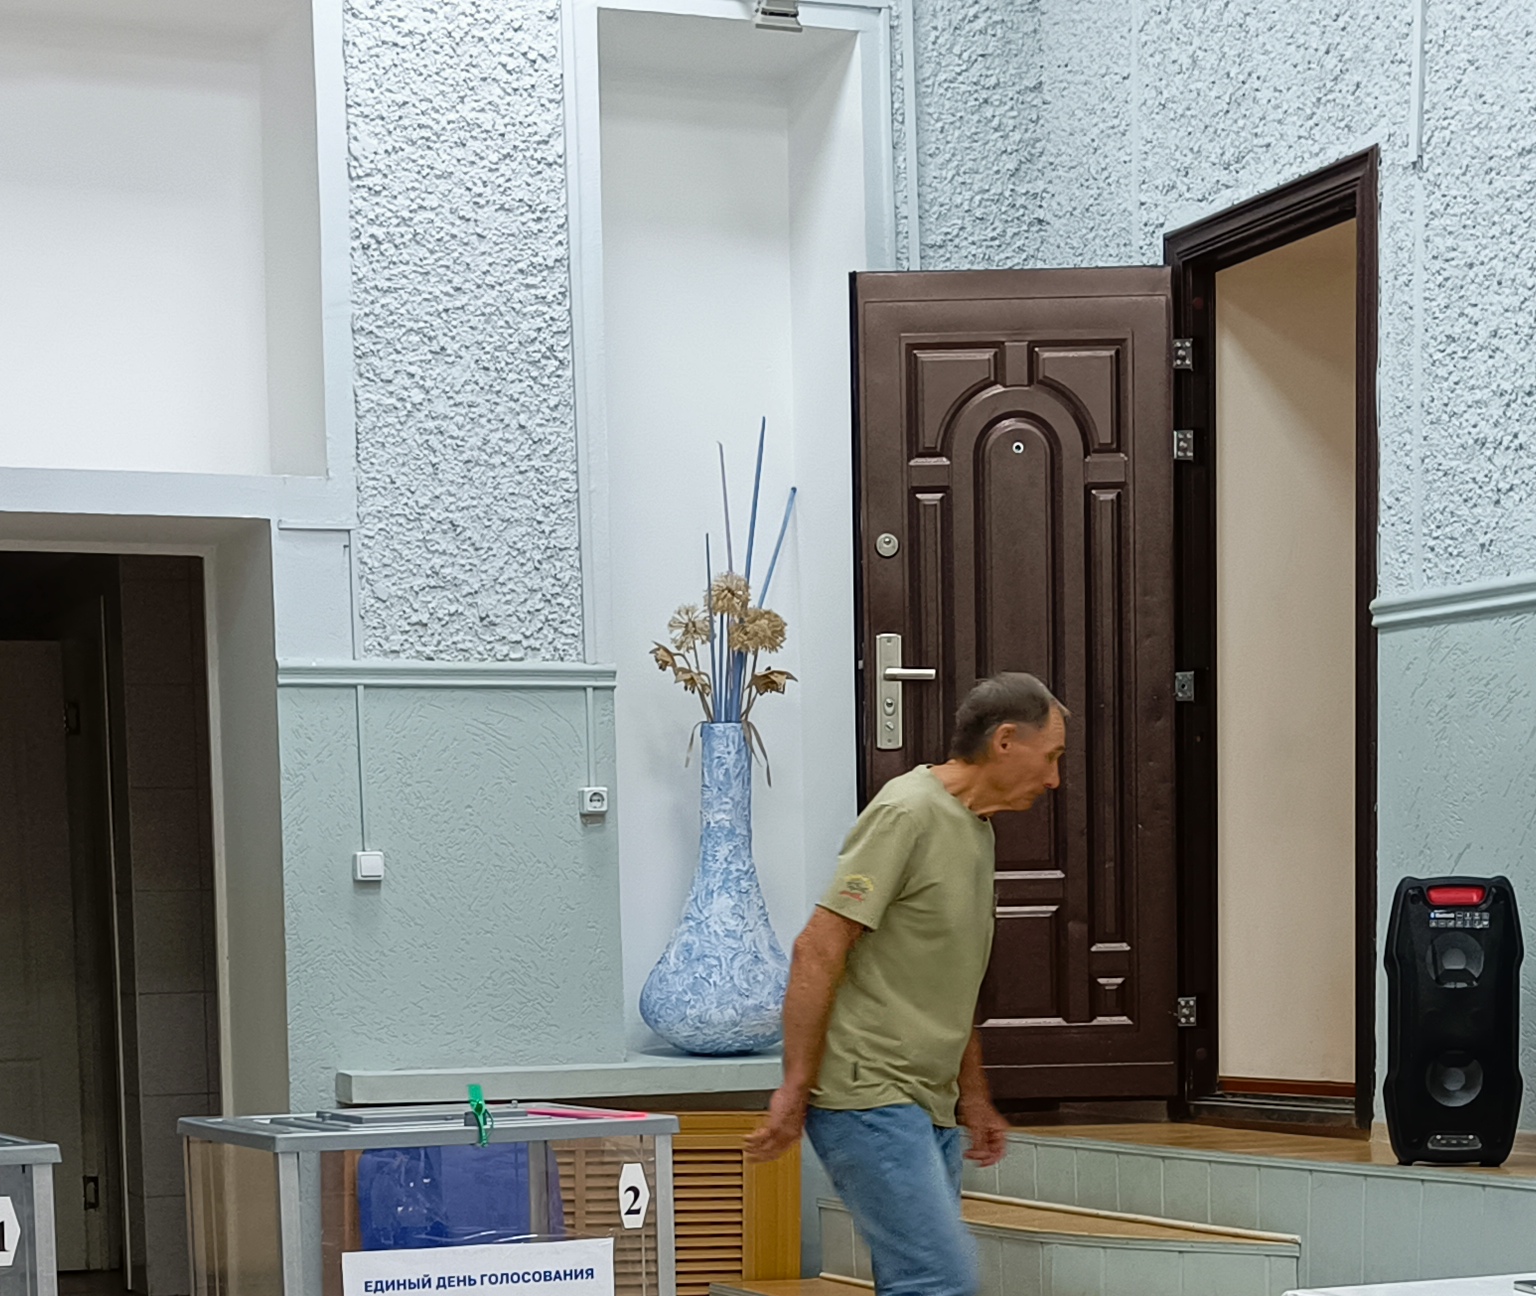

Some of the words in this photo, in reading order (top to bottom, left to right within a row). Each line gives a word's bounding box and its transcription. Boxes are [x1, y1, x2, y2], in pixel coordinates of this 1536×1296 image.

[624, 1185, 642, 1216] 2
[364, 1274, 432, 1294] ЕДИНЫЙ
[435, 1275, 477, 1290] ДЕНЬ
[480, 1267, 595, 1286] ГОЛОСОВАНИЯ
